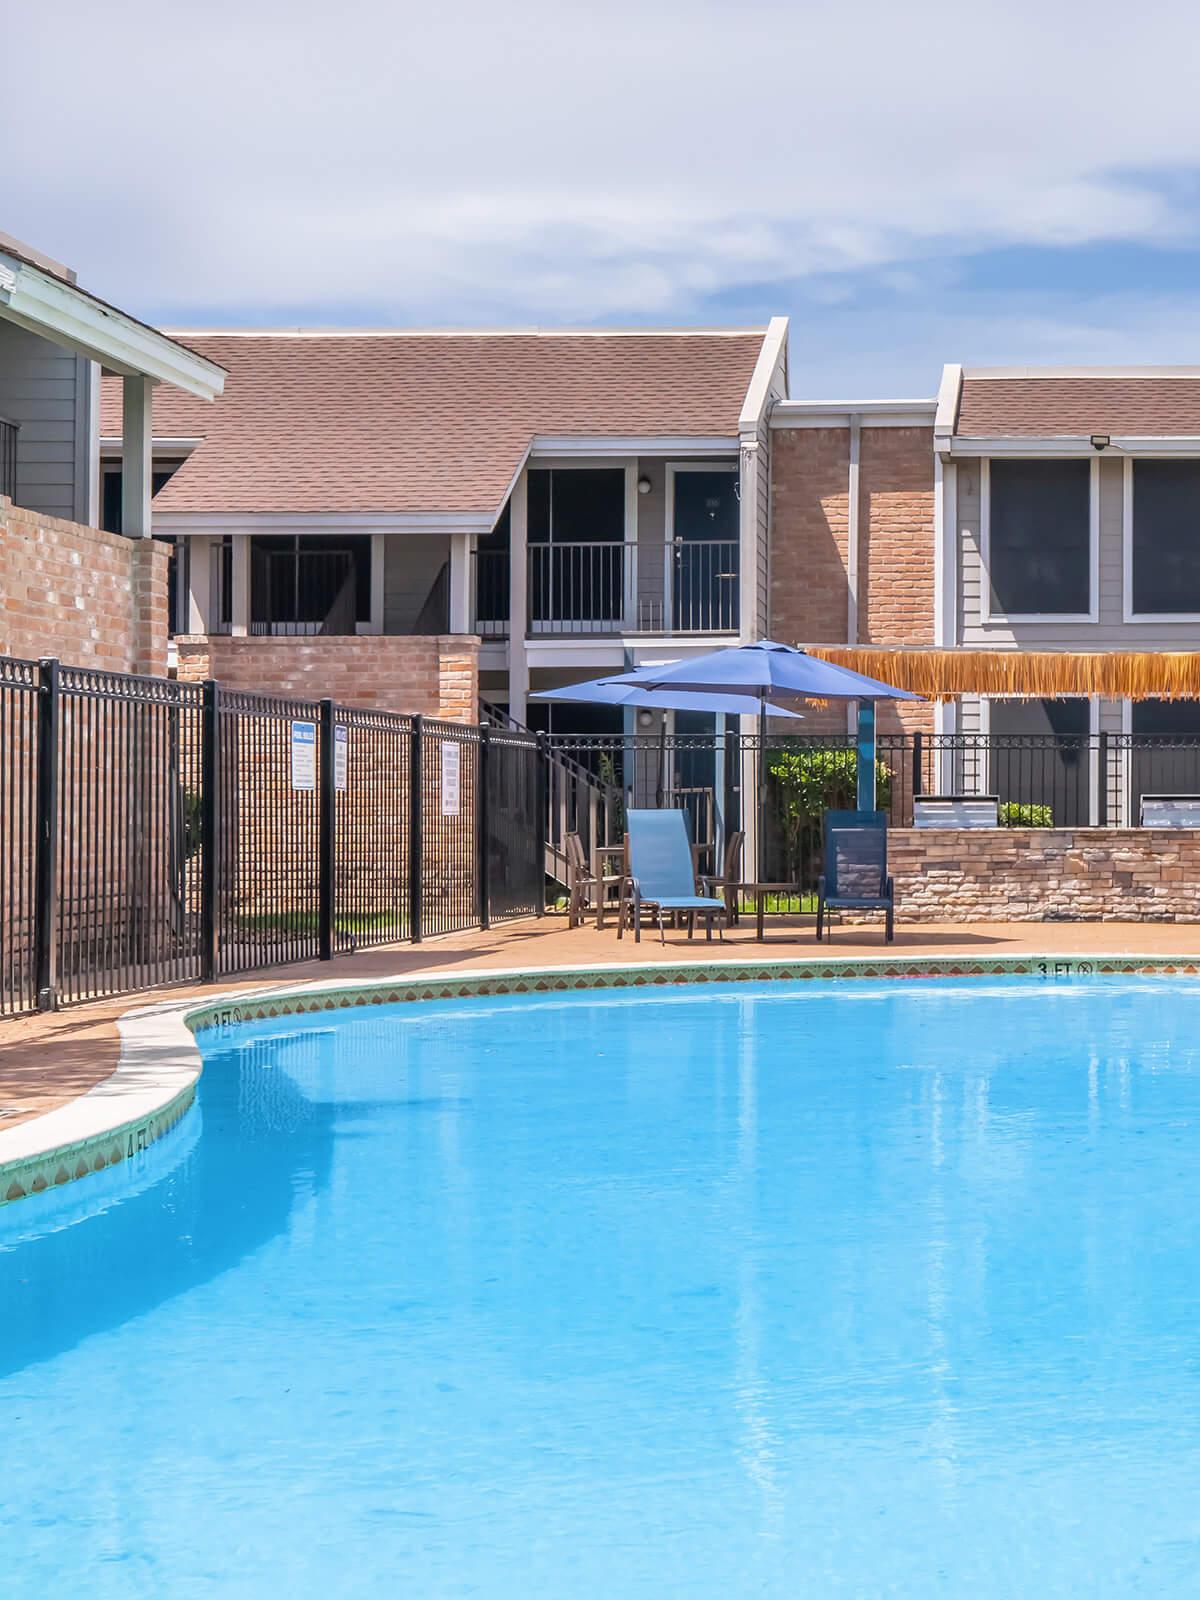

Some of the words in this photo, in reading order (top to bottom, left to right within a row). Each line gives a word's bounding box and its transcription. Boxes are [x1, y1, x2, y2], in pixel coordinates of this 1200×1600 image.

[1038, 963, 1047, 974] 3
[1055, 963, 1072, 975] FT
[221, 1011, 231, 1026] FT
